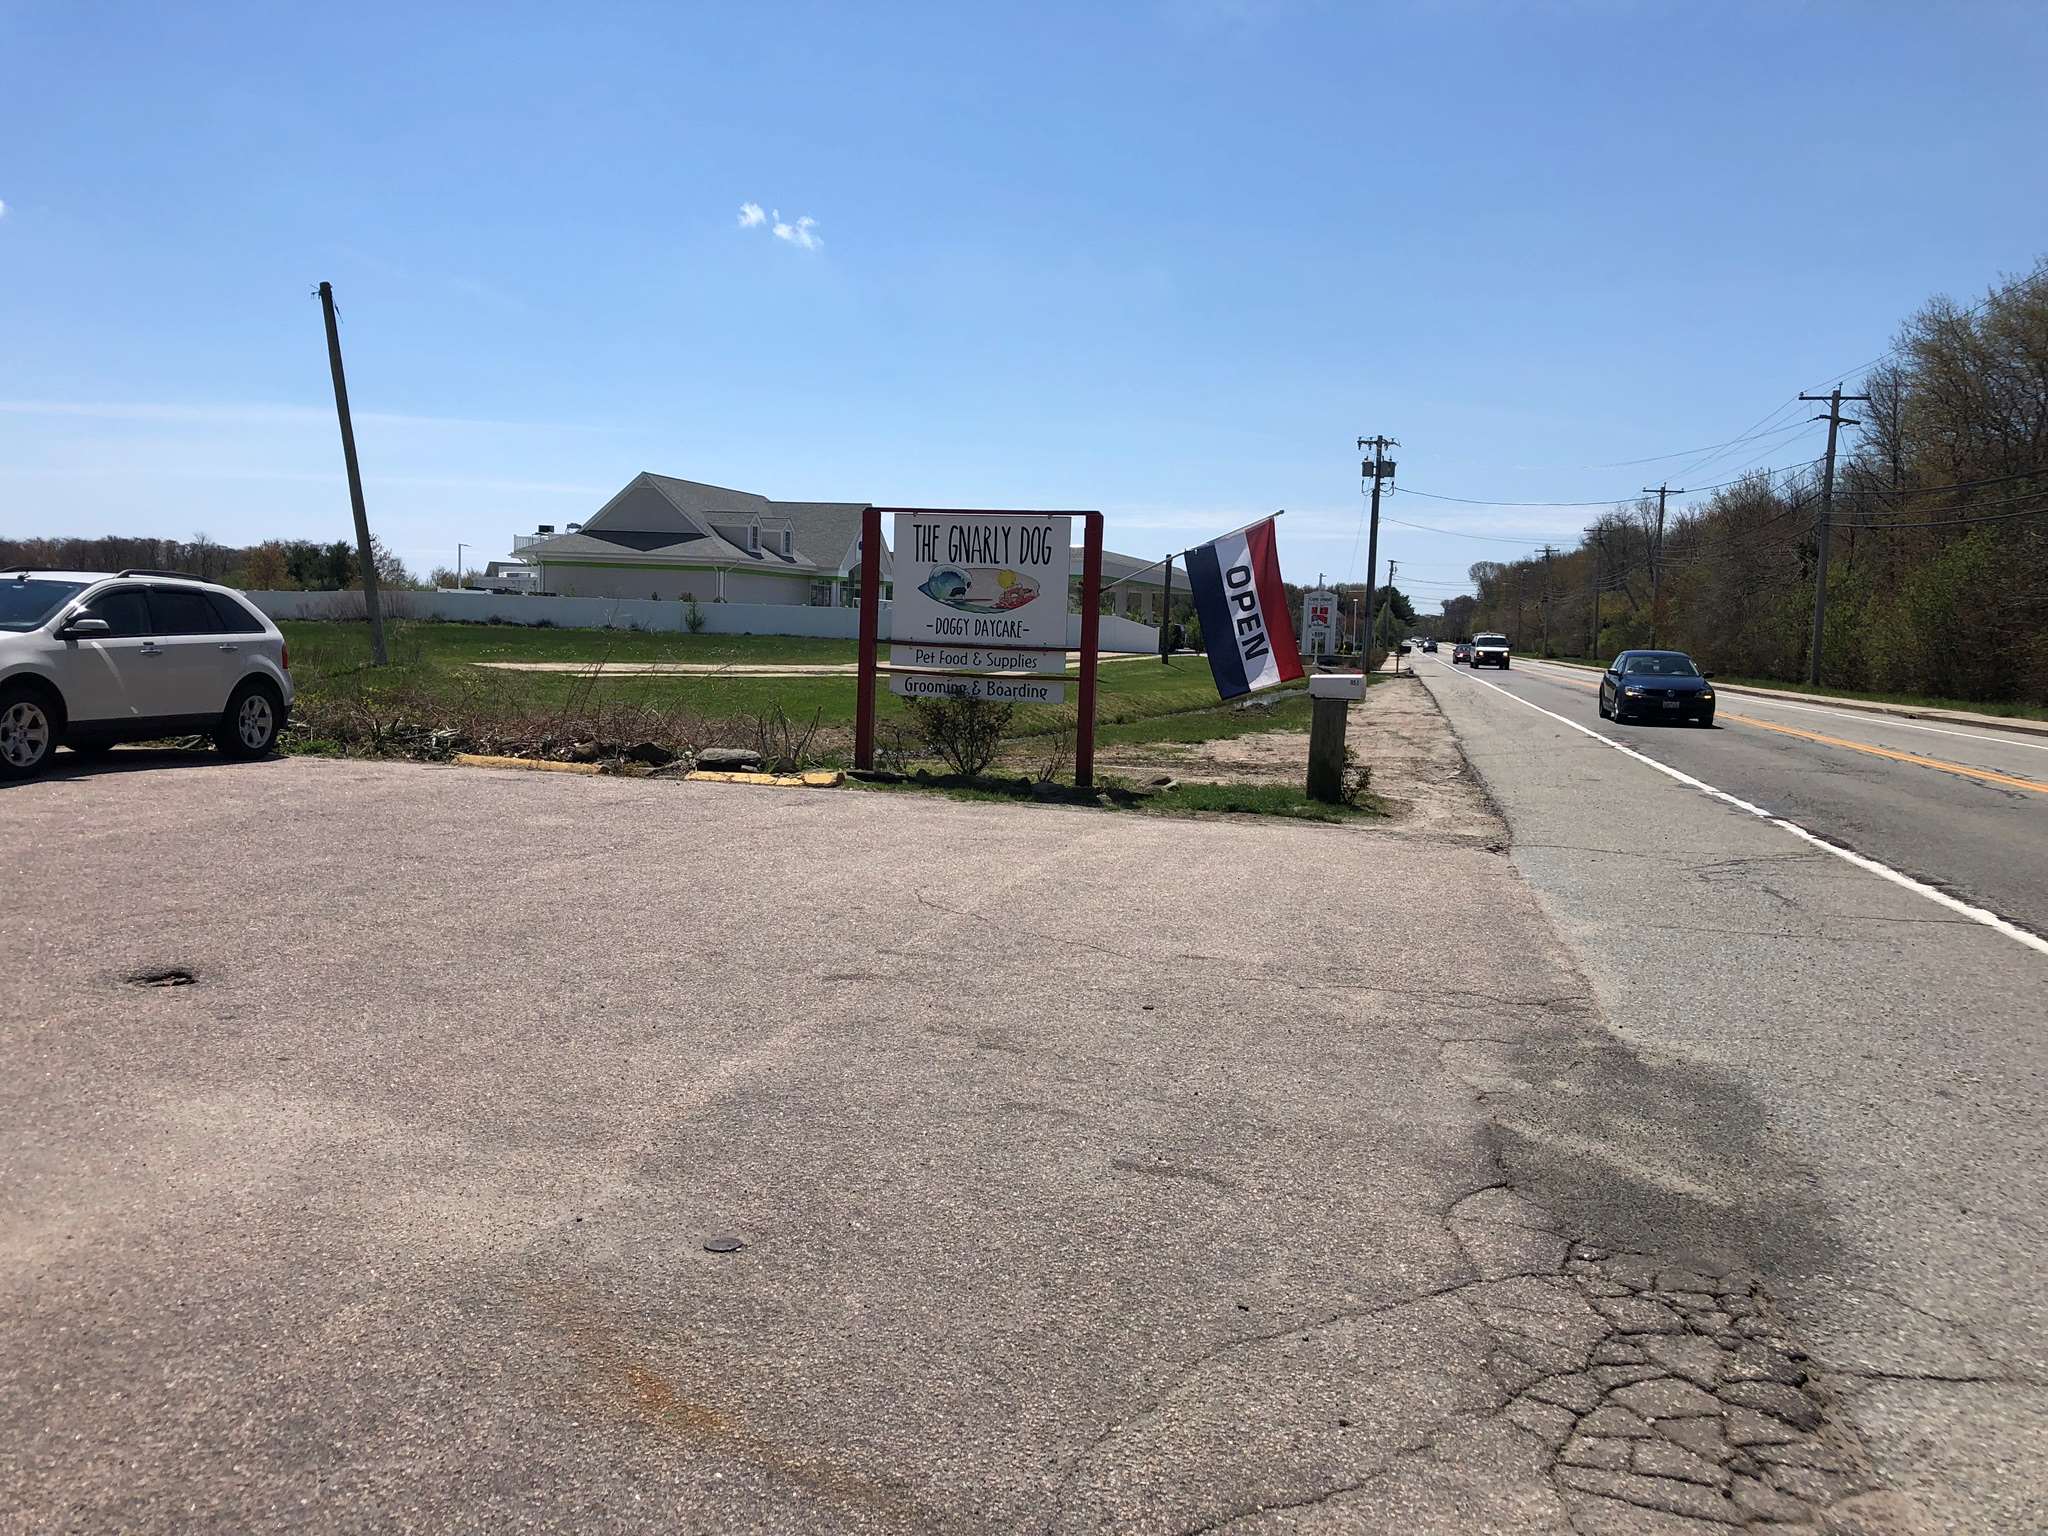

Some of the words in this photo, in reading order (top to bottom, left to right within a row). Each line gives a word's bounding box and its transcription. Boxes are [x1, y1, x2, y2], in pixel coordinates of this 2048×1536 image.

[913, 524, 941, 562] THE
[948, 525, 1012, 564] GNARLY
[1019, 526, 1053, 565] DOG
[1226, 566, 1269, 660] OPEN
[915, 649, 935, 664] Pet
[938, 650, 968, 665] Food
[972, 652, 983, 666] &
[986, 652, 1038, 670] Supplies
[972, 680, 982, 695] &
[987, 681, 1048, 701] Boarding
